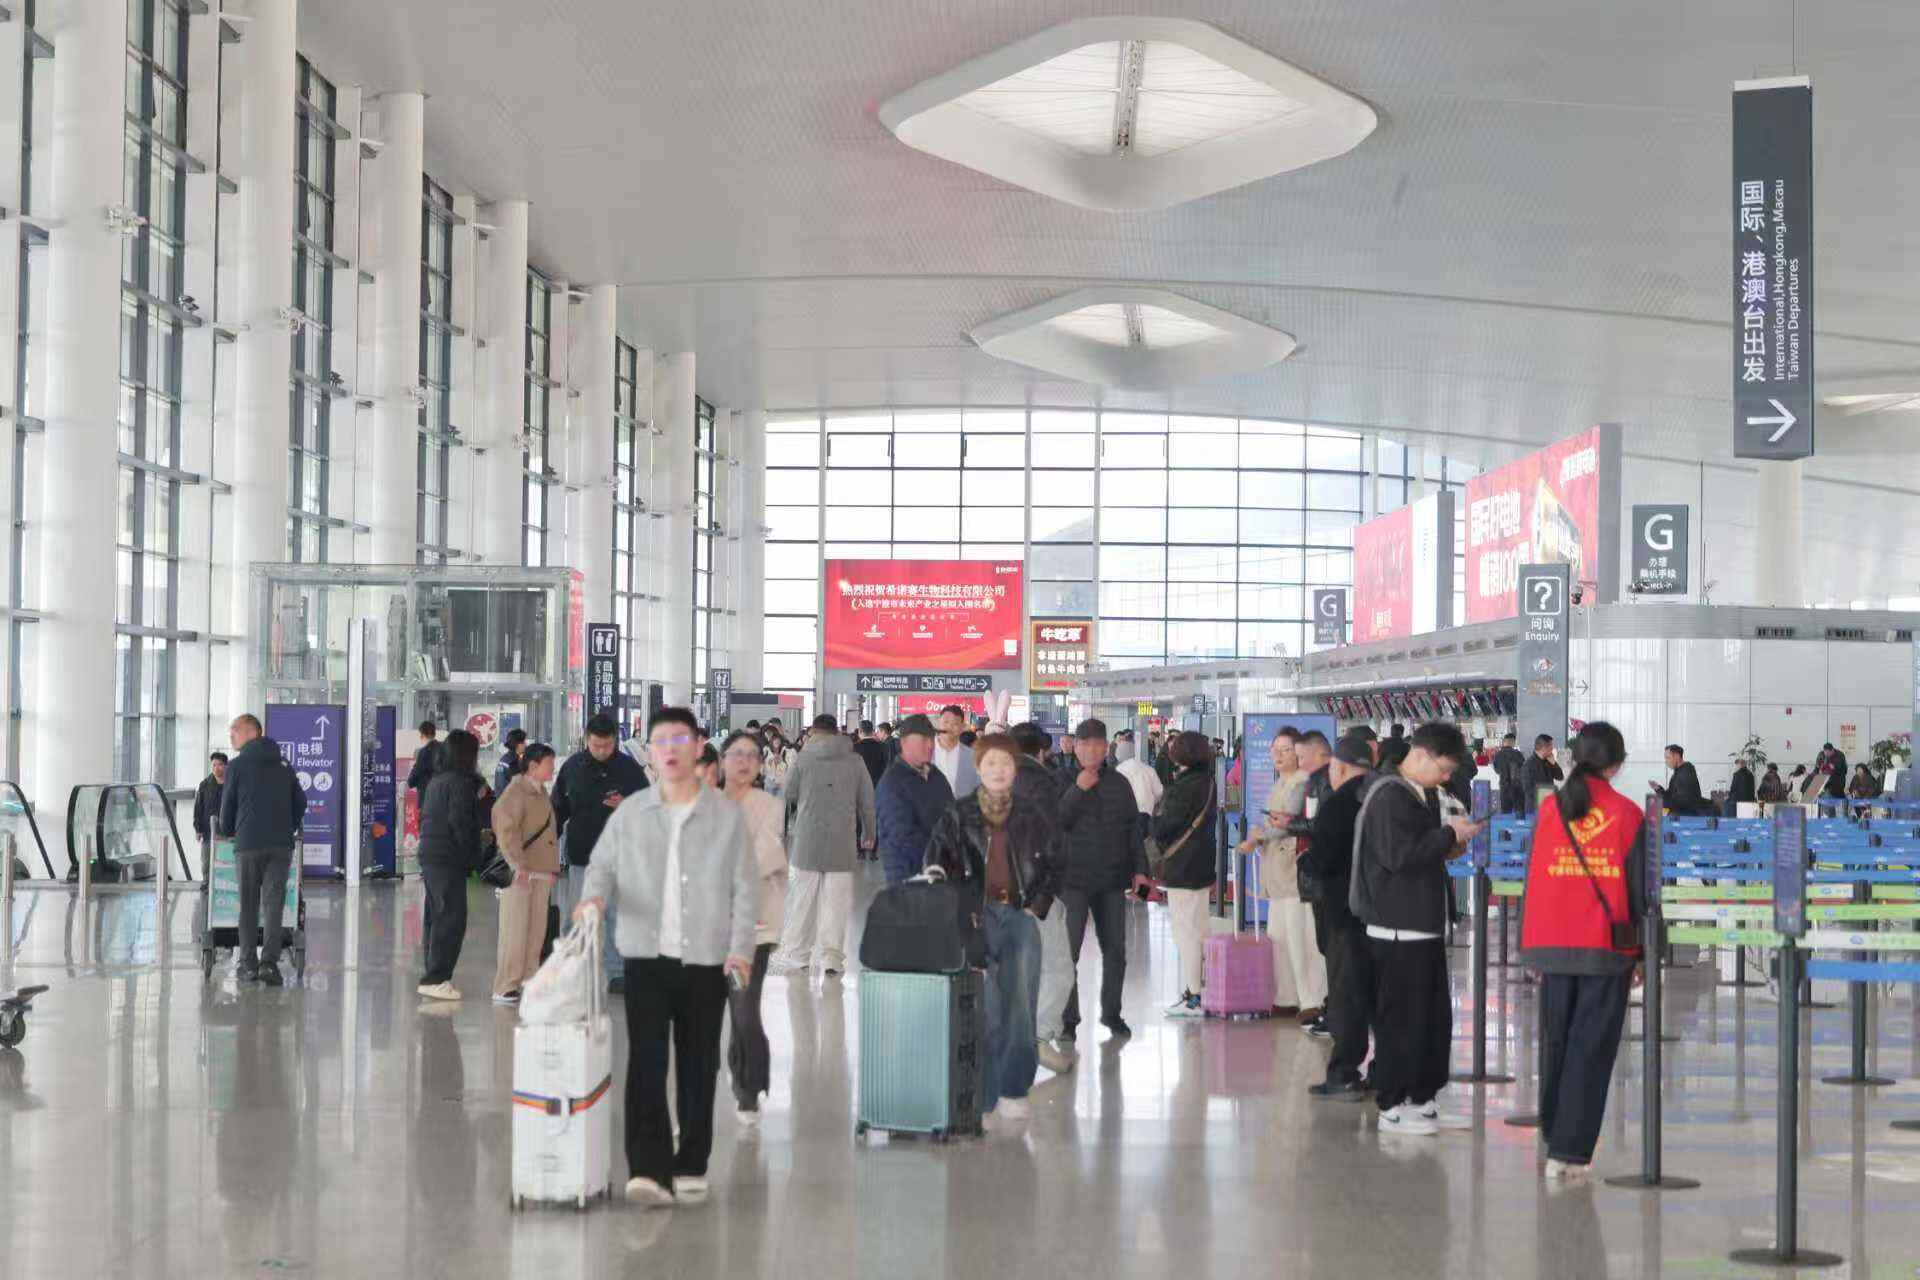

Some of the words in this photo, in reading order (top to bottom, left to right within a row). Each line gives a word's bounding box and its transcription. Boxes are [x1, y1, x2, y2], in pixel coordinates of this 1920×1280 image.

[1741, 180, 1766, 383] 国际、港澳台出发
[1787, 257, 1801, 331] Departures
[1788, 333, 1799, 381] Taiwan
[1644, 513, 1673, 551] G
[1320, 594, 1337, 617] G
[1531, 616, 1554, 630] 问询
[1525, 631, 1560, 643] Enquiry
[297, 743, 323, 756] 电梯
[297, 757, 334, 768] Elevator
